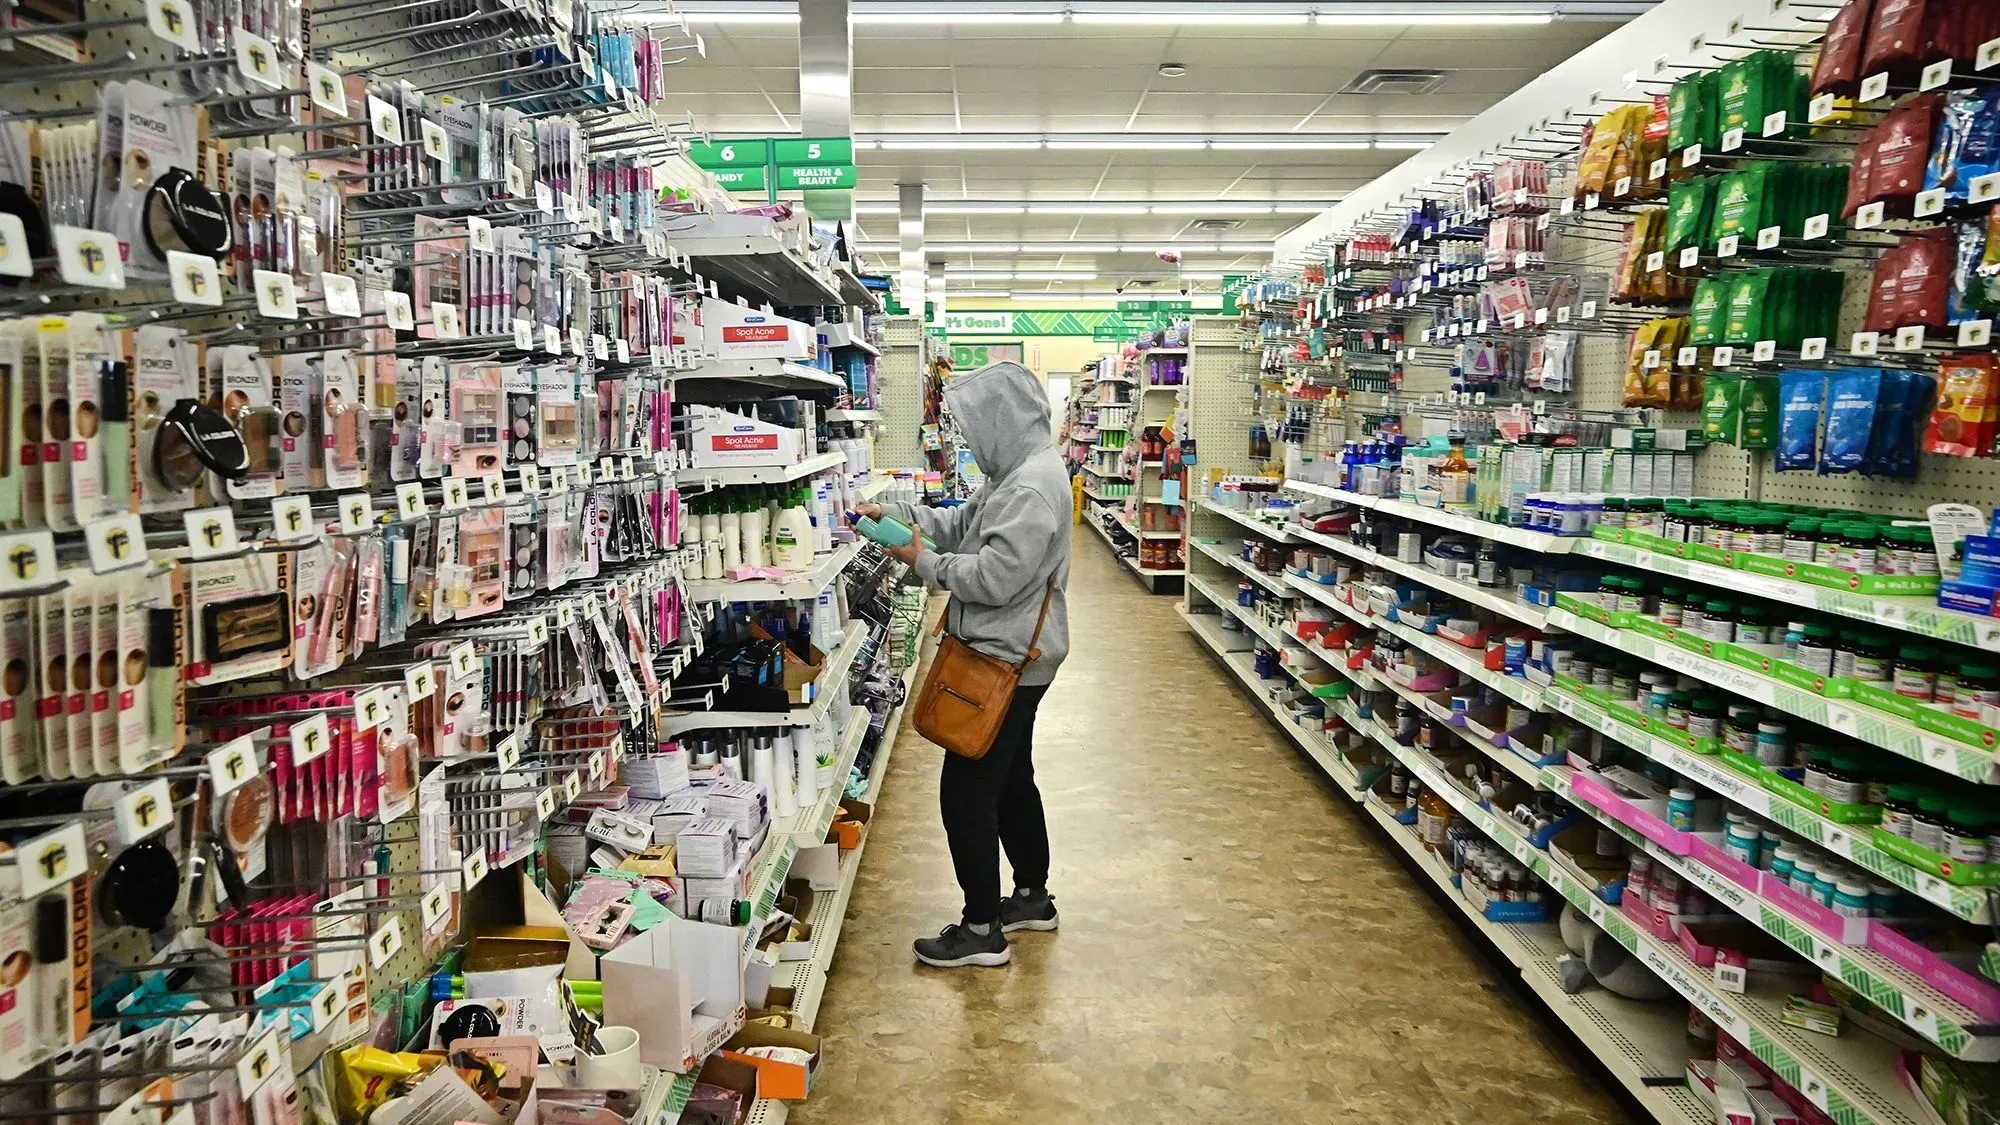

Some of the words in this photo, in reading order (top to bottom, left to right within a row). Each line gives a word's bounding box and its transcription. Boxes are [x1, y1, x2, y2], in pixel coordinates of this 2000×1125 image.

[129, 113, 168, 133] POWDER
[443, 114, 473, 130] EYESHADOW
[720, 146, 735, 160] 6
[808, 144, 820, 158] 5
[714, 174, 744, 182] ANDY
[793, 168, 832, 177] HEALTH
[834, 168, 844, 177] &
[798, 177, 838, 185] BEAUTY
[964, 316, 1006, 328] Gone!
[736, 328, 753, 336] Spot
[227, 376, 260, 384] BRONZER
[283, 378, 304, 386] STICK
[725, 436, 742, 445] Spot
[197, 575, 236, 588] BRONZER
[1687, 861, 1708, 881] Value
[1707, 875, 1744, 906] Everyday
[74, 971, 88, 1013] L.A.
[1648, 952, 1666, 972] Grab
[1672, 970, 1697, 996] Before
[1709, 1001, 1736, 1026] Gone!
[516, 998, 526, 1030] POWDER
